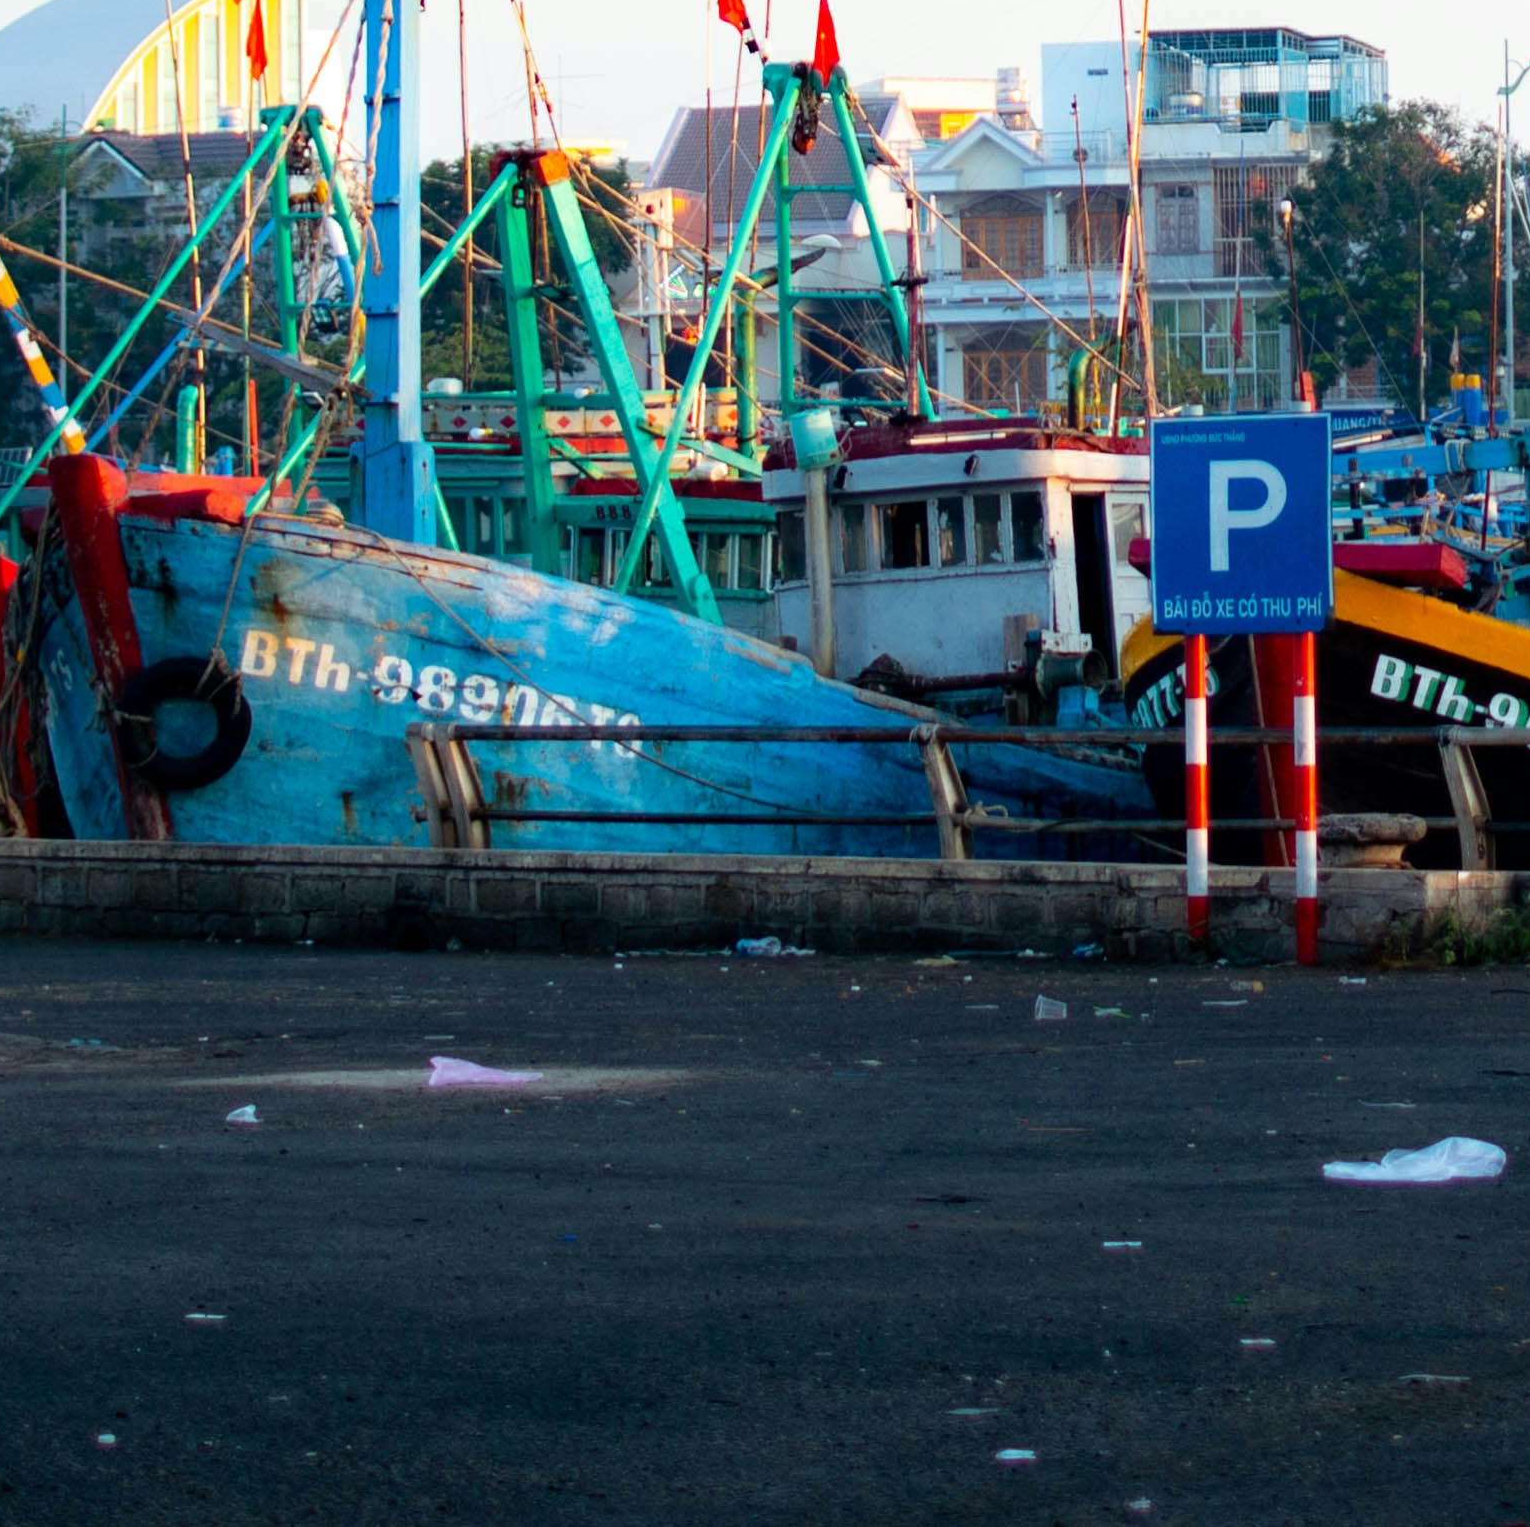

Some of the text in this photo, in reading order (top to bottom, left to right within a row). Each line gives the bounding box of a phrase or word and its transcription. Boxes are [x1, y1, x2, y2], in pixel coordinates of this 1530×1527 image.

[1209, 459, 1287, 572] P
[1164, 591, 1323, 619] BÃI ĐỖ XE CÓ THU PHÍ
